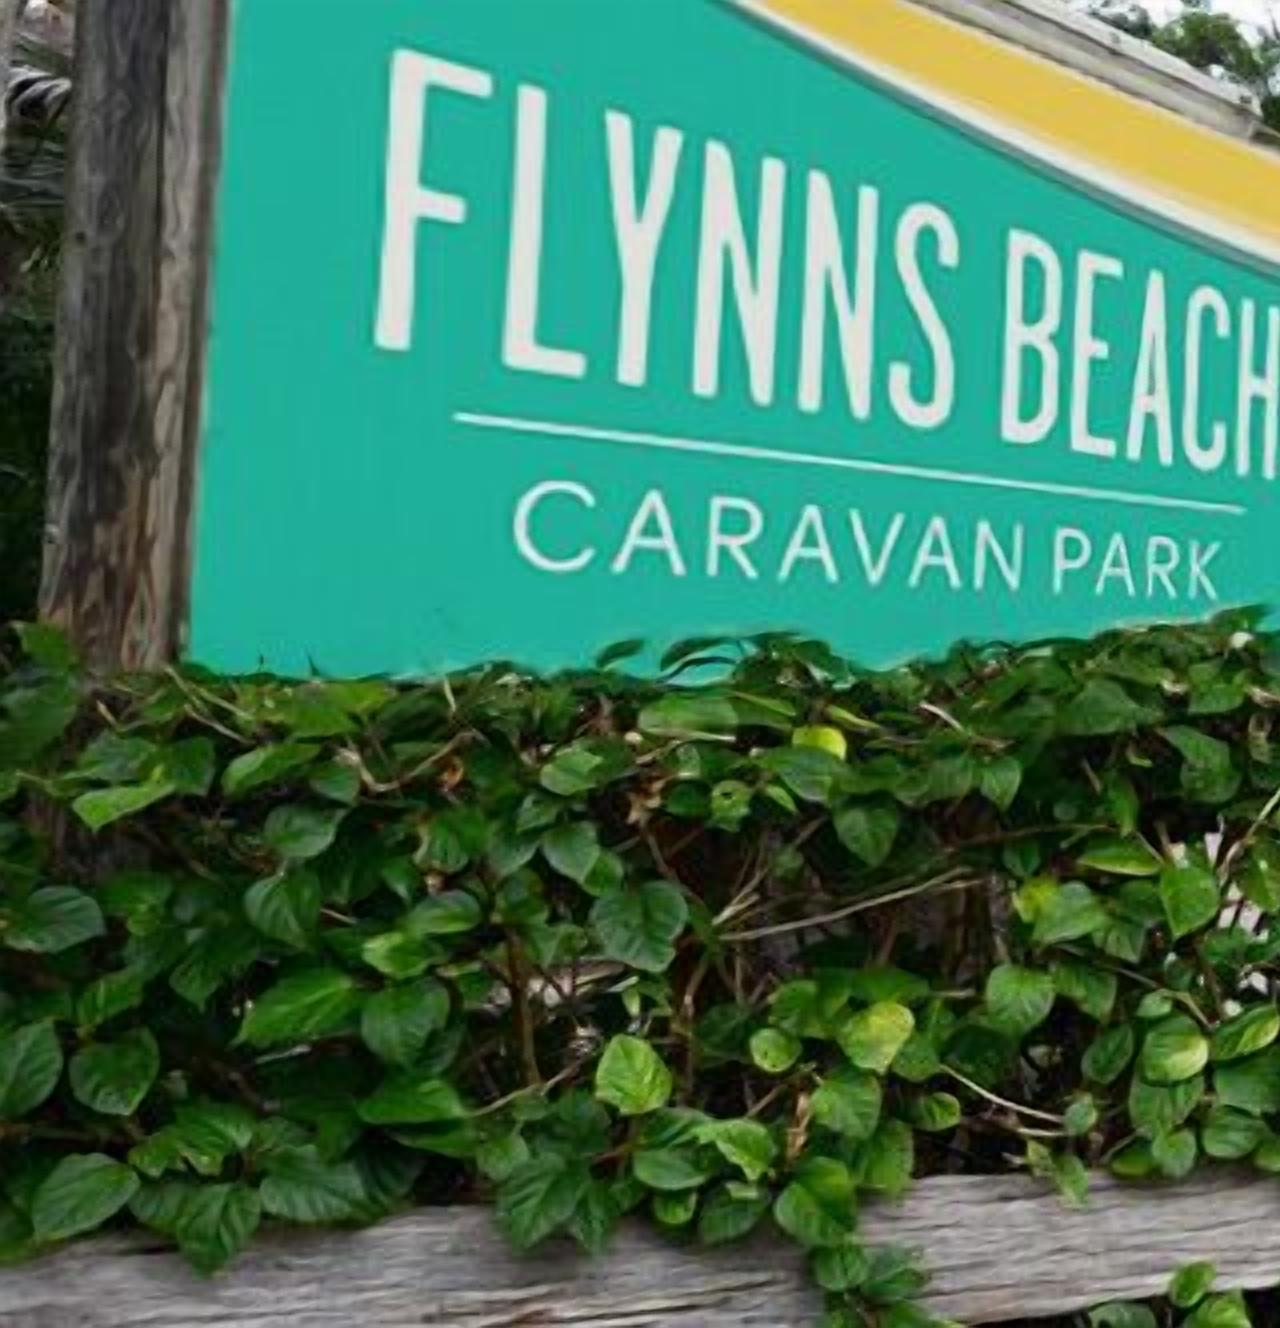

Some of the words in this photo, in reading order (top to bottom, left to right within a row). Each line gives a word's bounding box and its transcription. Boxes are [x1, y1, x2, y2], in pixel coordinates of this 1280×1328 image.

[374, 48, 960, 428] FLYNNS
[512, 480, 1024, 592] CARAVAN
[1052, 526, 1222, 599] PARK
